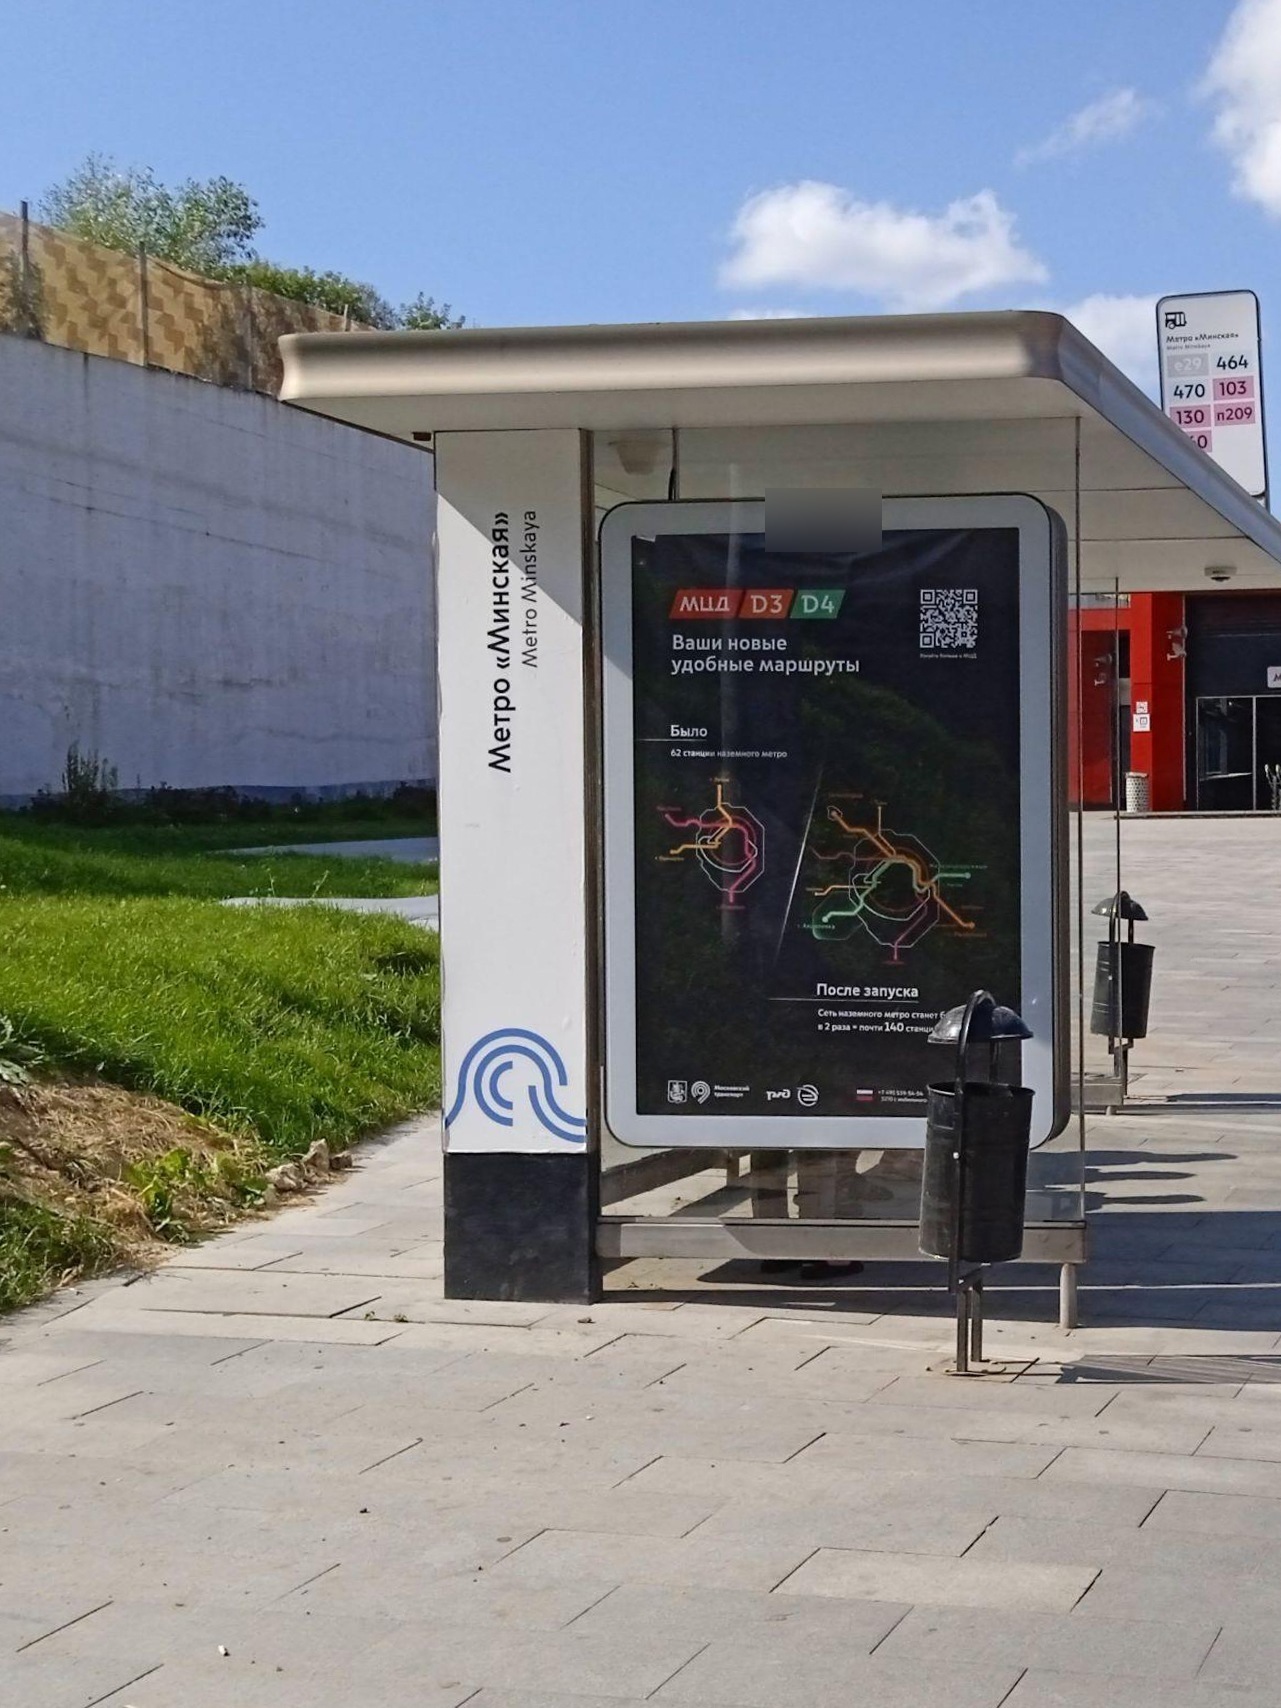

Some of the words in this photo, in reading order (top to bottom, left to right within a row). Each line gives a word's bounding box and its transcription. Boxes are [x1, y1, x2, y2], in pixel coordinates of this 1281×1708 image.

[1166, 335, 1193, 343] Метро
[1216, 354, 1249, 370] 464
[1173, 383, 1205, 399] 470
[1219, 381, 1247, 396] 103
[1176, 409, 1205, 424] 130
[1217, 407, 1253, 421] п209
[519, 510, 540, 602] Minskaya
[487, 511, 510, 670] «Минская»
[679, 596, 730, 612] МЦД
[750, 595, 783, 613] D3
[801, 595, 835, 613] D4
[522, 608, 538, 668] Metro
[672, 634, 723, 651] Ваши
[728, 638, 788, 651] новые
[671, 656, 754, 675] удобные
[759, 659, 860, 676] маршруты
[488, 678, 516, 773] Метро
[670, 724, 708, 737] Было
[670, 748, 682, 757] 62
[683, 750, 716, 758] станции
[717, 750, 760, 758] наземного
[761, 750, 788, 759] метро
[816, 983, 861, 996] После
[863, 985, 919, 999] запуска
[817, 1008, 838, 1018] Сеть
[838, 1009, 883, 1018] наземного
[883, 1010, 910, 1020] метро
[911, 1012, 938, 1020] станет
[824, 1022, 831, 1031] 2
[831, 1024, 851, 1032] раза
[859, 1024, 883, 1032] почти
[884, 1021, 905, 1032] 140
[905, 1025, 934, 1033] станци
